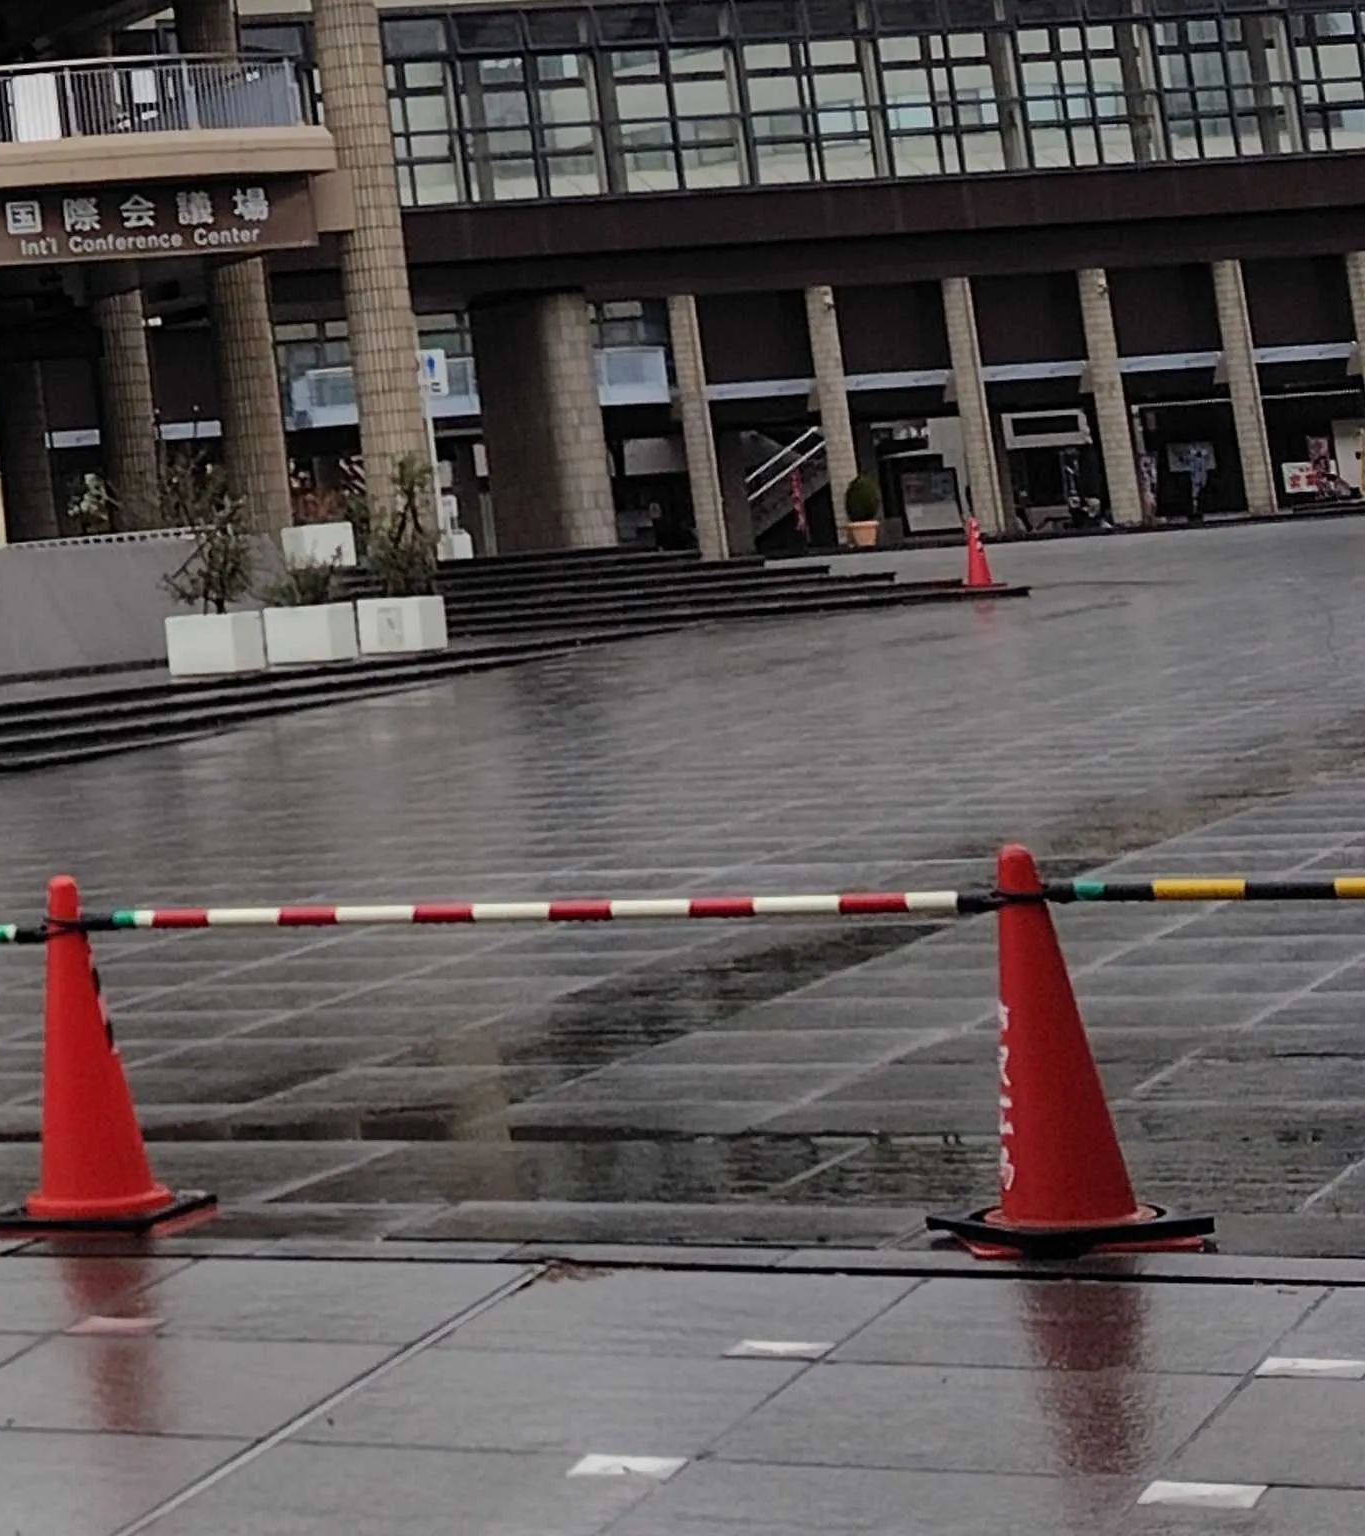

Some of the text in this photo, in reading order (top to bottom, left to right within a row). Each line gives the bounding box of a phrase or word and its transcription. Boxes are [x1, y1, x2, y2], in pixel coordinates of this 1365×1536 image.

[5, 187, 269, 235] 国際会議場
[21, 226, 261, 257] Int'l Conference Center
